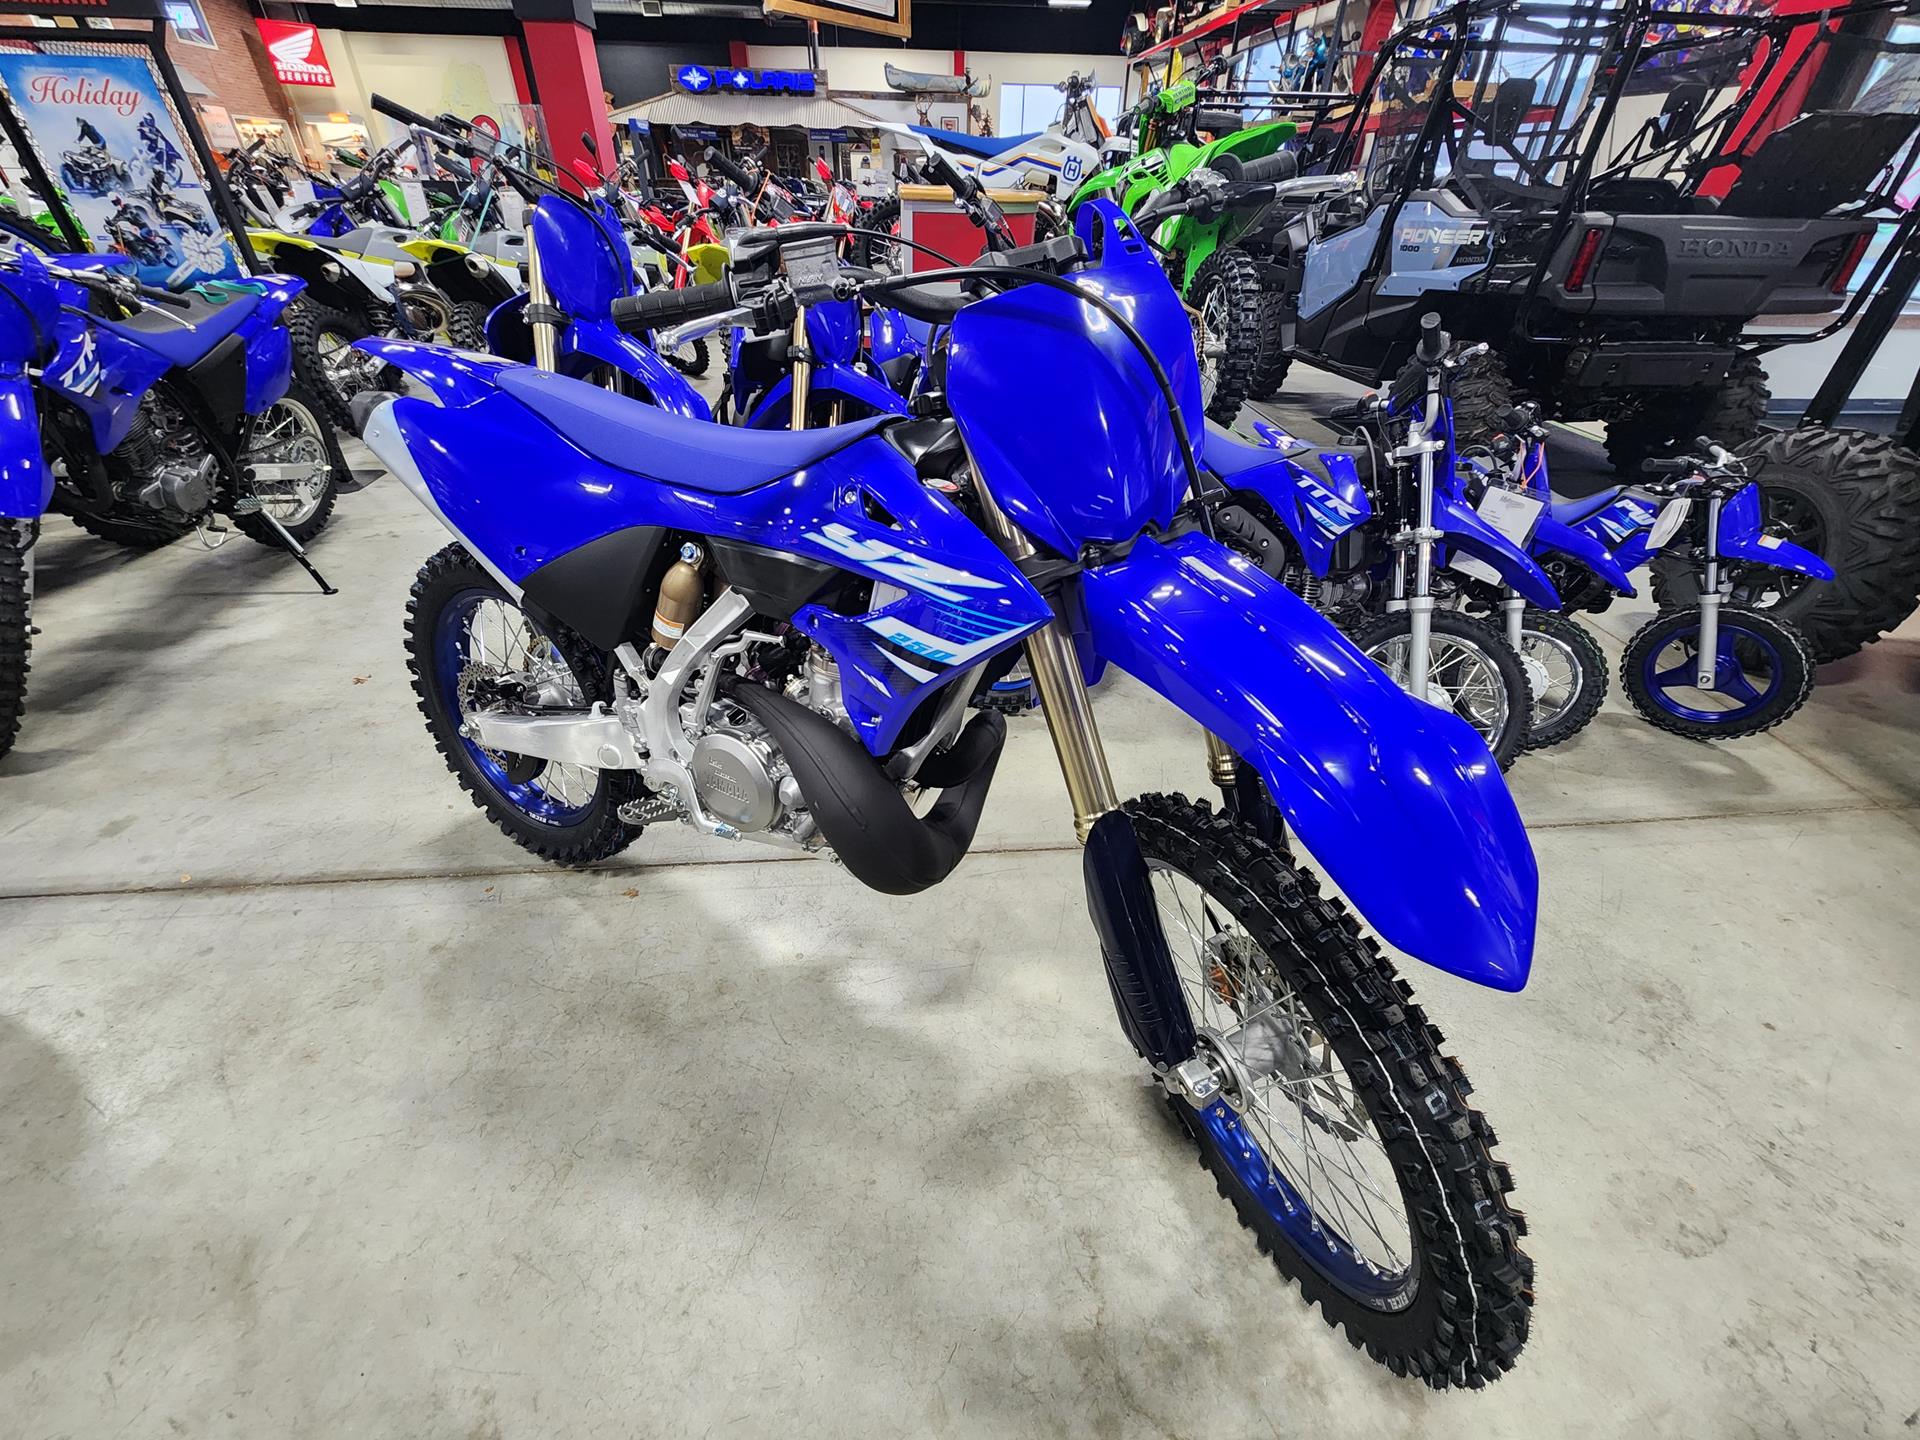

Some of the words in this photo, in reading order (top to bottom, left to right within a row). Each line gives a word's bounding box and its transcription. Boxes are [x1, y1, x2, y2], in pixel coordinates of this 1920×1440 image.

[274, 60, 329, 74] HONDA
[278, 70, 333, 84] SERVICE
[714, 68, 817, 92] POLARIS
[29, 75, 141, 116] Holiday
[1401, 227, 1485, 245] PIONEER
[1678, 239, 1794, 258] HONDA
[59, 331, 97, 388] TTR
[1296, 475, 1362, 521] TTR
[801, 522, 1008, 602] YZ
[888, 632, 958, 662] 250
[1387, 1291, 1410, 1310] EXCEL
